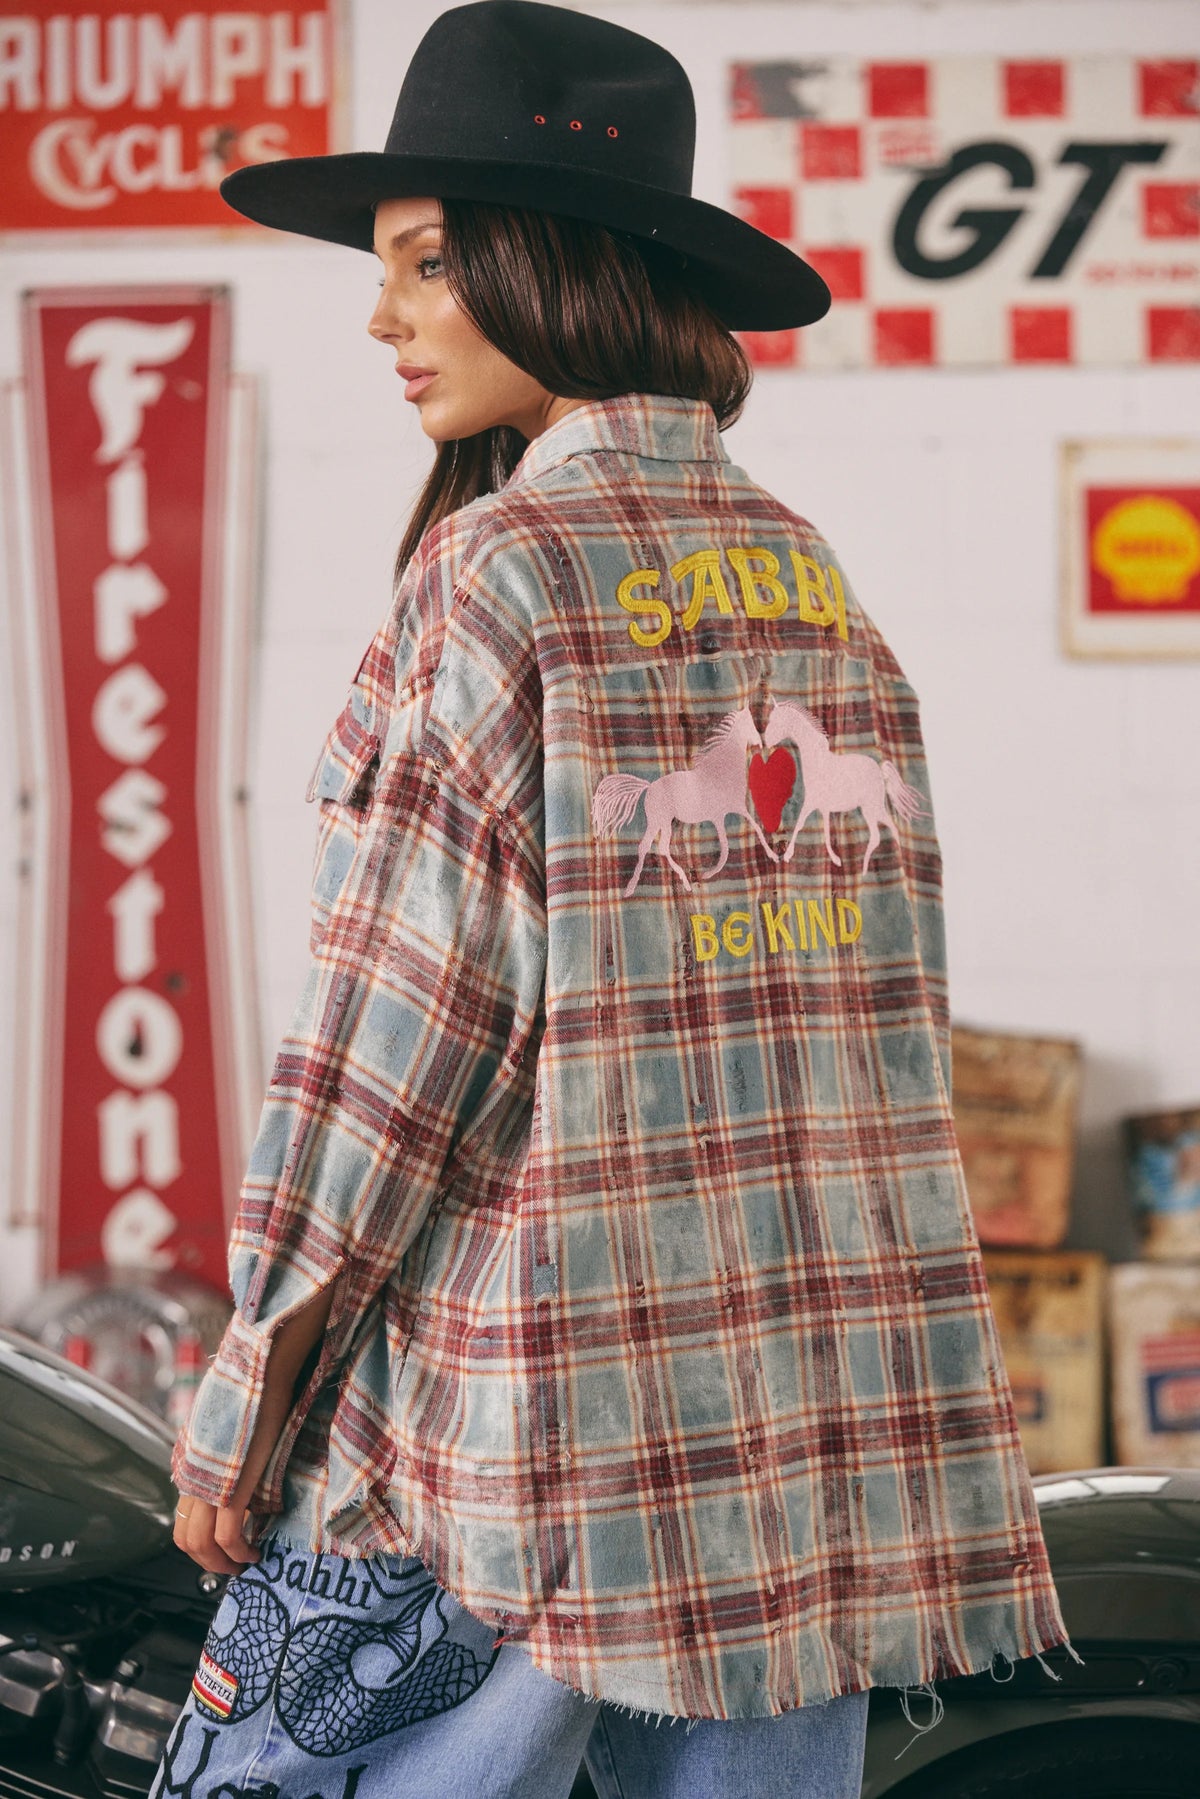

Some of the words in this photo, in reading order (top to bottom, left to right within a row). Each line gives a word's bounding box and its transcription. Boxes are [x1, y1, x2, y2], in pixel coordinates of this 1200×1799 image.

[892, 139, 1168, 282] GT
[615, 546, 849, 648] SABBI
[65, 316, 196, 1270] Firestone
[691, 912, 754, 962] BE
[761, 899, 862, 954] KIND
